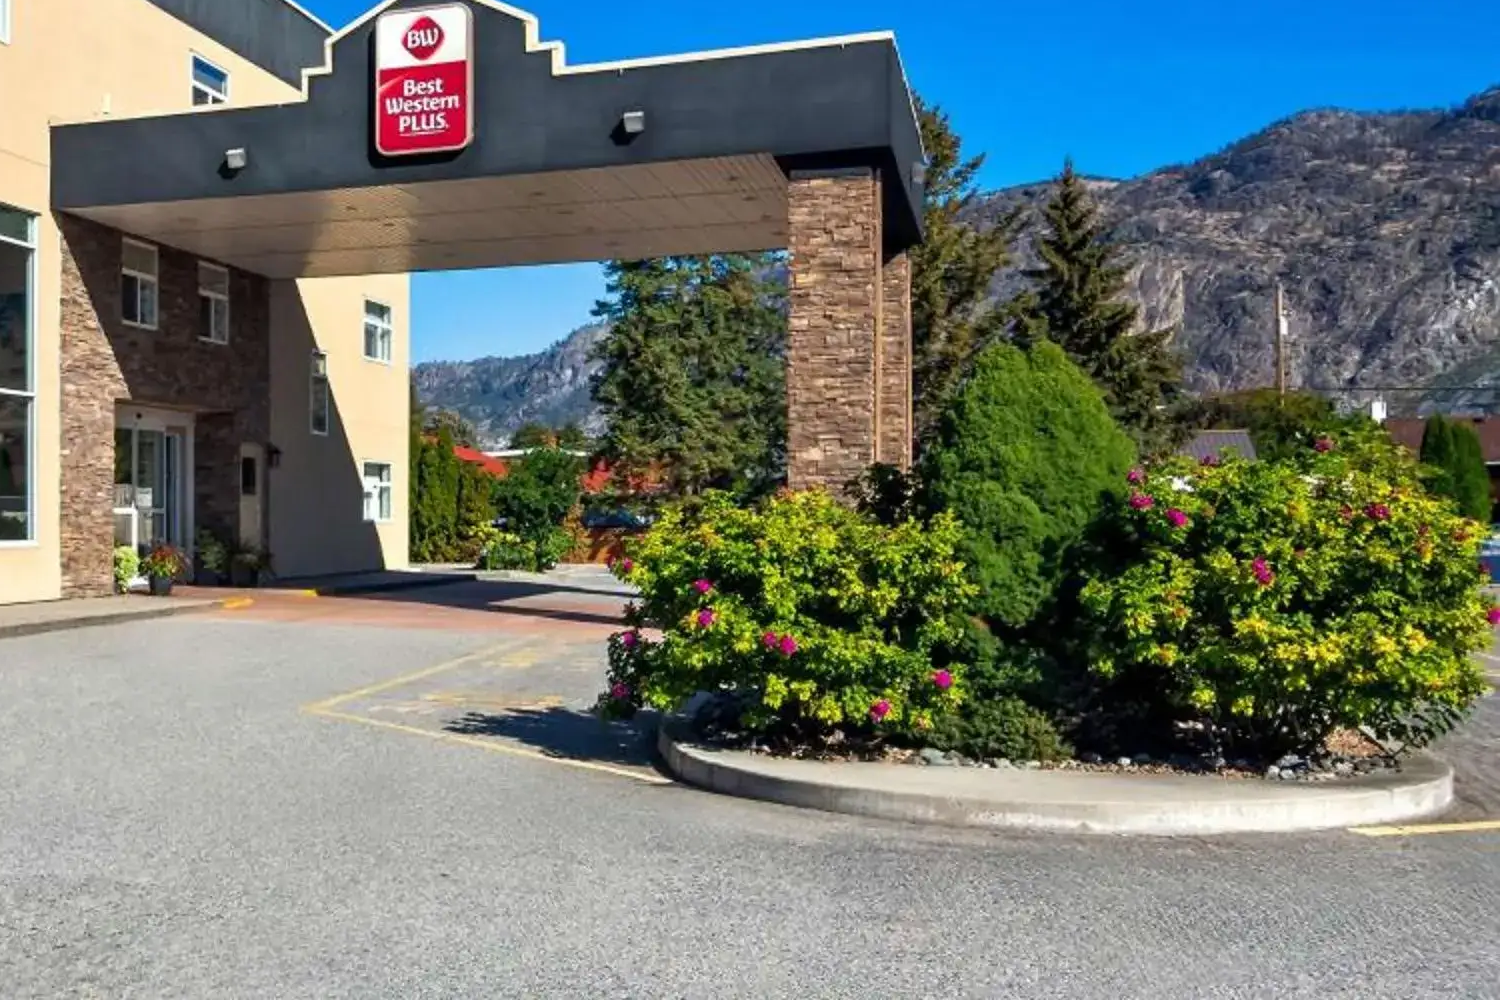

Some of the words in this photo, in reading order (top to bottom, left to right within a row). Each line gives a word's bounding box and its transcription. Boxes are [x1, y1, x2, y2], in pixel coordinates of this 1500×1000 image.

[407, 27, 439, 49] BW
[403, 77, 444, 97] Best
[385, 95, 460, 115] Western
